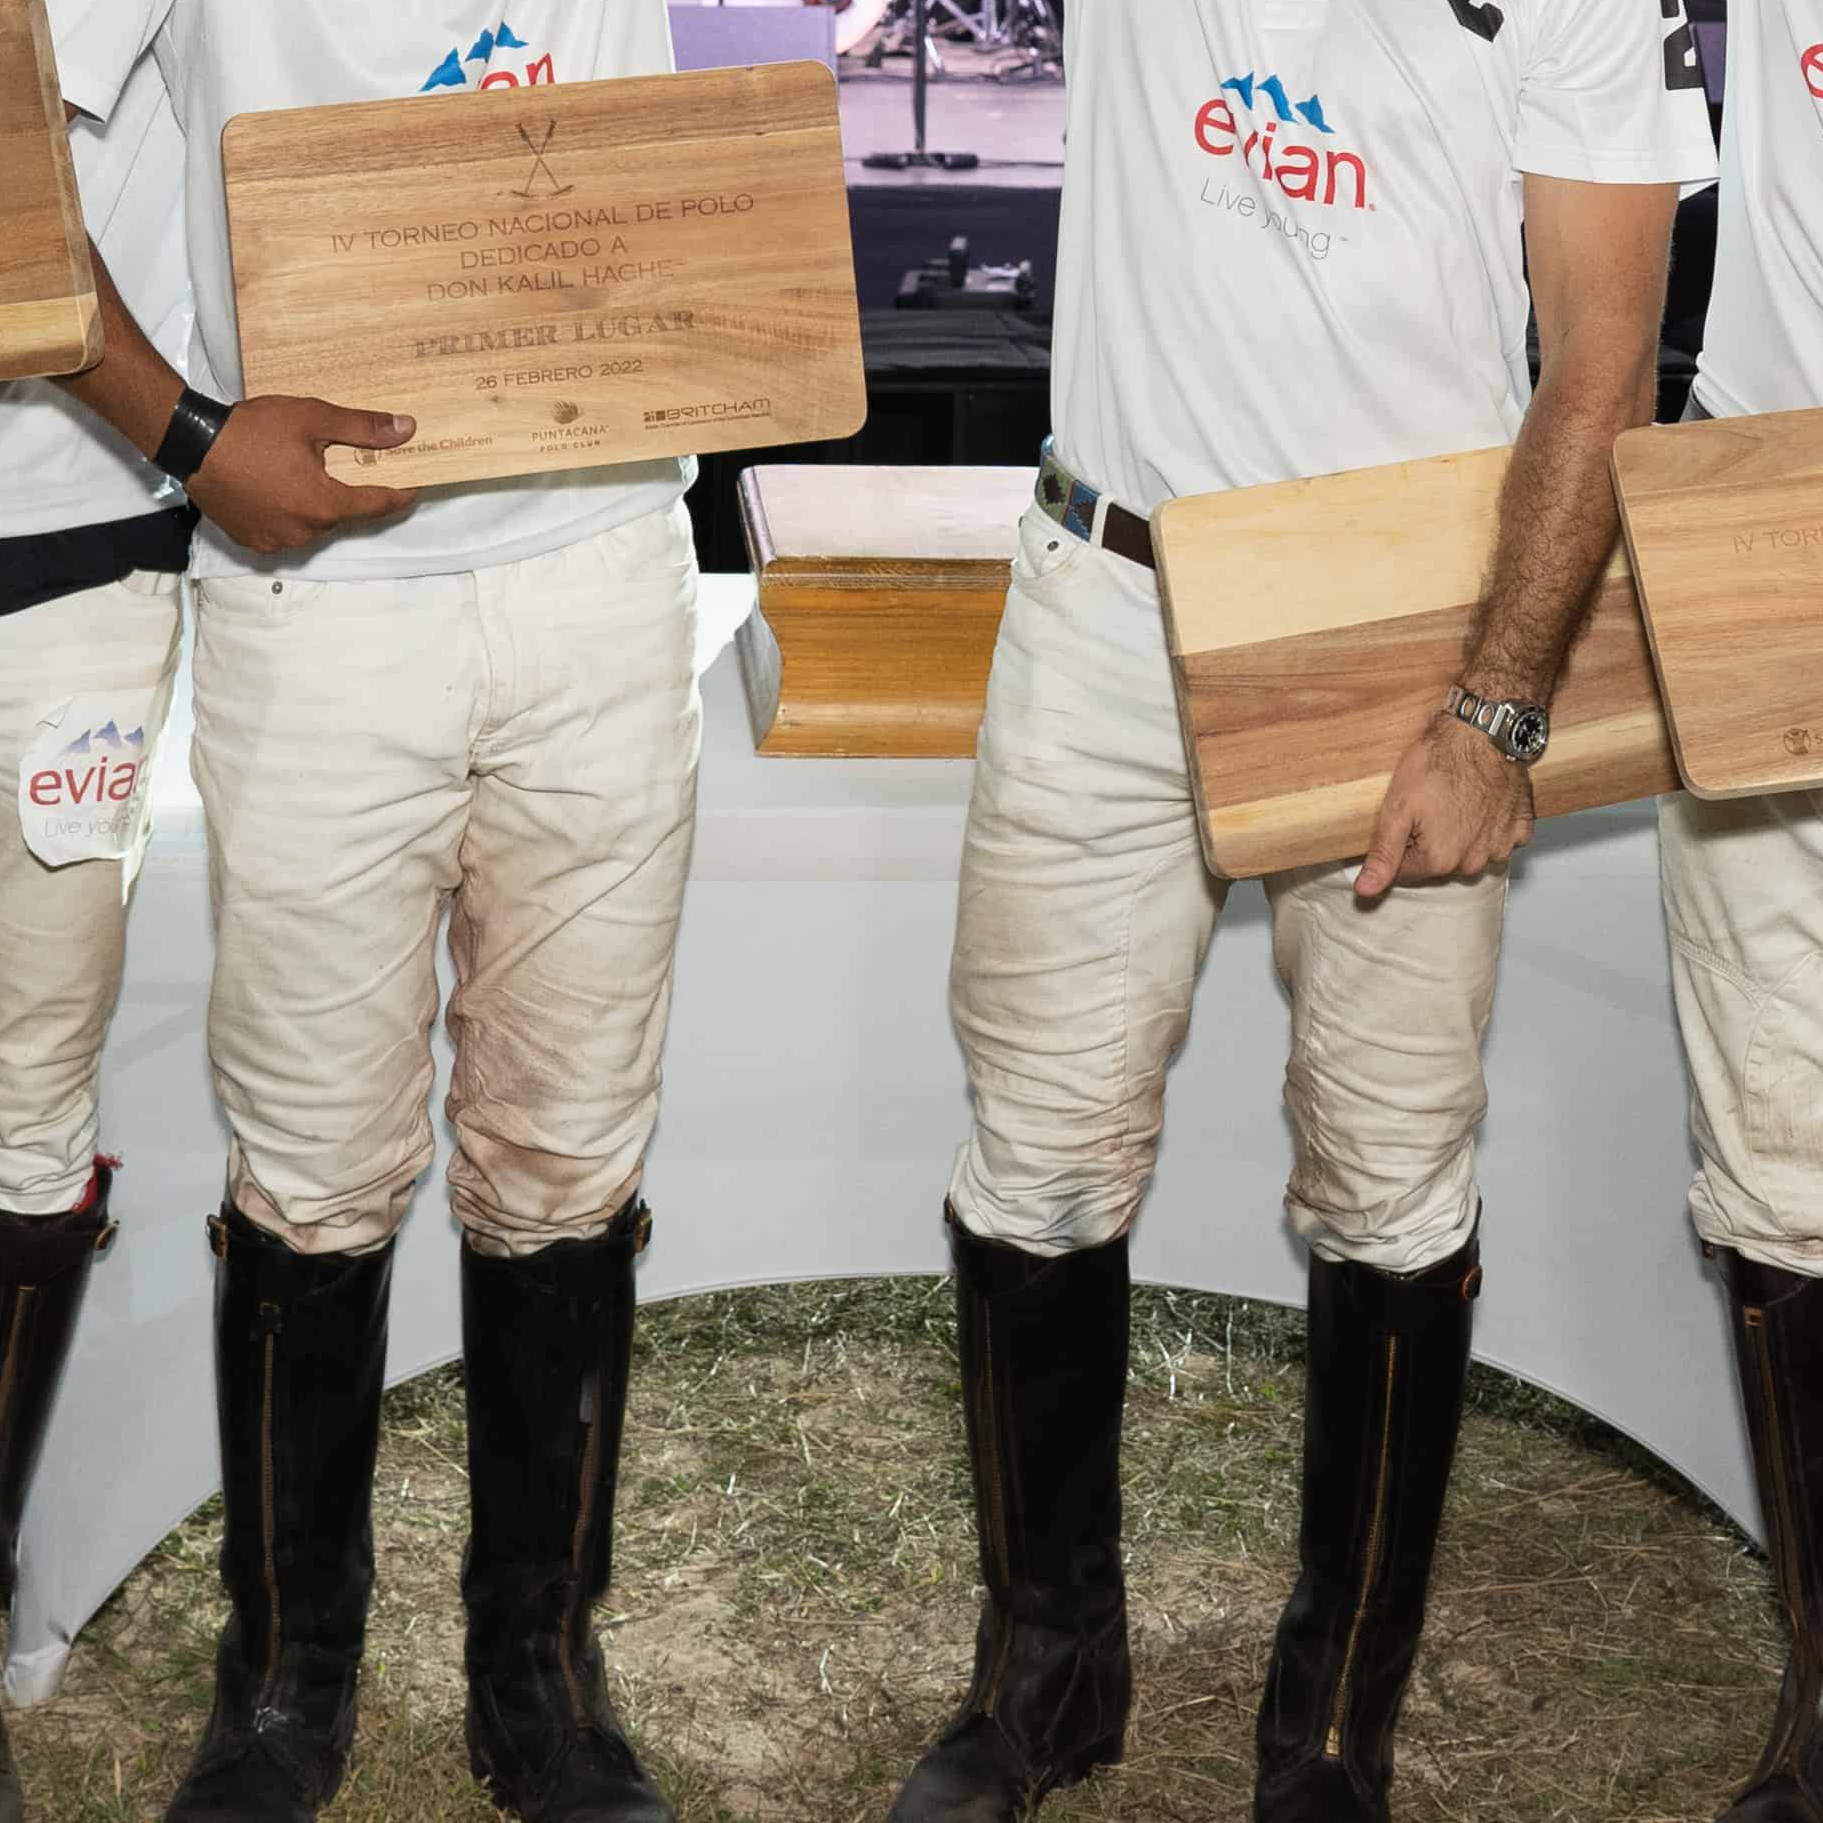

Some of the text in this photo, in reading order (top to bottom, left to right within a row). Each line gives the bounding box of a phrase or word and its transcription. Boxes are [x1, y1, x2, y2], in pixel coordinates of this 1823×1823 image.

[331, 192, 755, 254] IV TORNEO NACIONAL DE POLO
[1200, 176, 1332, 259] Live young
[460, 235, 629, 269] DEDICADO A
[427, 279, 488, 302] DON
[497, 269, 574, 295] KALIL
[414, 309, 695, 359] PRIMER LUGAR
[476, 359, 644, 390] 26 FEBRERO 2022
[666, 397, 771, 421] BRITCHAM
[417, 441, 438, 455] the
[439, 434, 493, 453] Children
[531, 424, 607, 442] PUNTACANA
[1732, 535, 1755, 555] IV
[44, 818, 82, 838] Live
